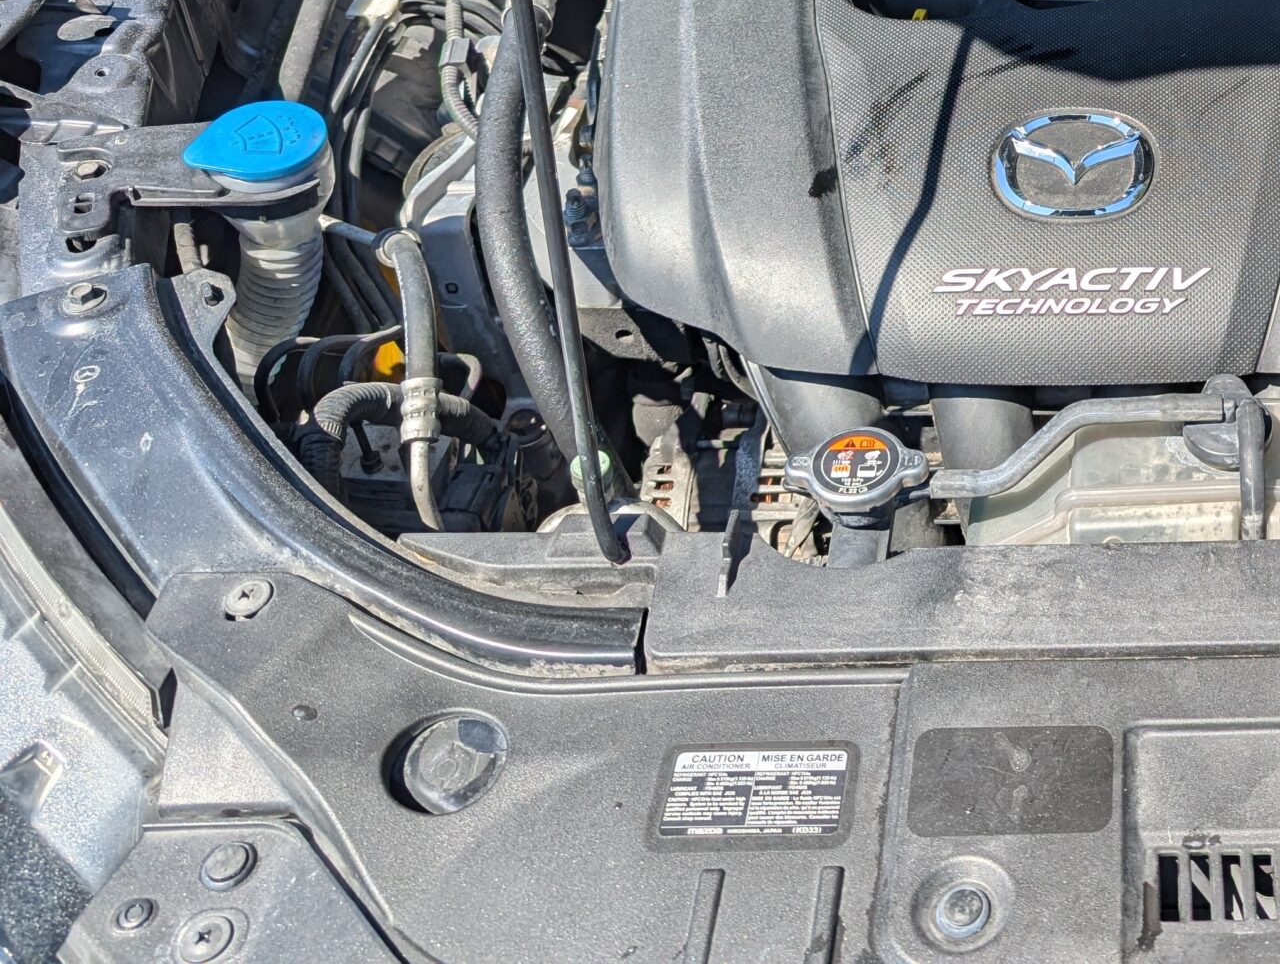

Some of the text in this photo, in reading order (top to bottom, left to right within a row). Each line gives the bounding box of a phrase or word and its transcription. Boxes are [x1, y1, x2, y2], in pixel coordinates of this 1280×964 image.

[932, 266, 1212, 293] SKYACTIV
[955, 297, 1188, 316] TECHNOLOGY
[691, 754, 745, 763] CAUTION
[761, 753, 844, 763] MISE EN GARDE
[687, 827, 724, 835] mazda
[792, 826, 822, 834] (KD33)
